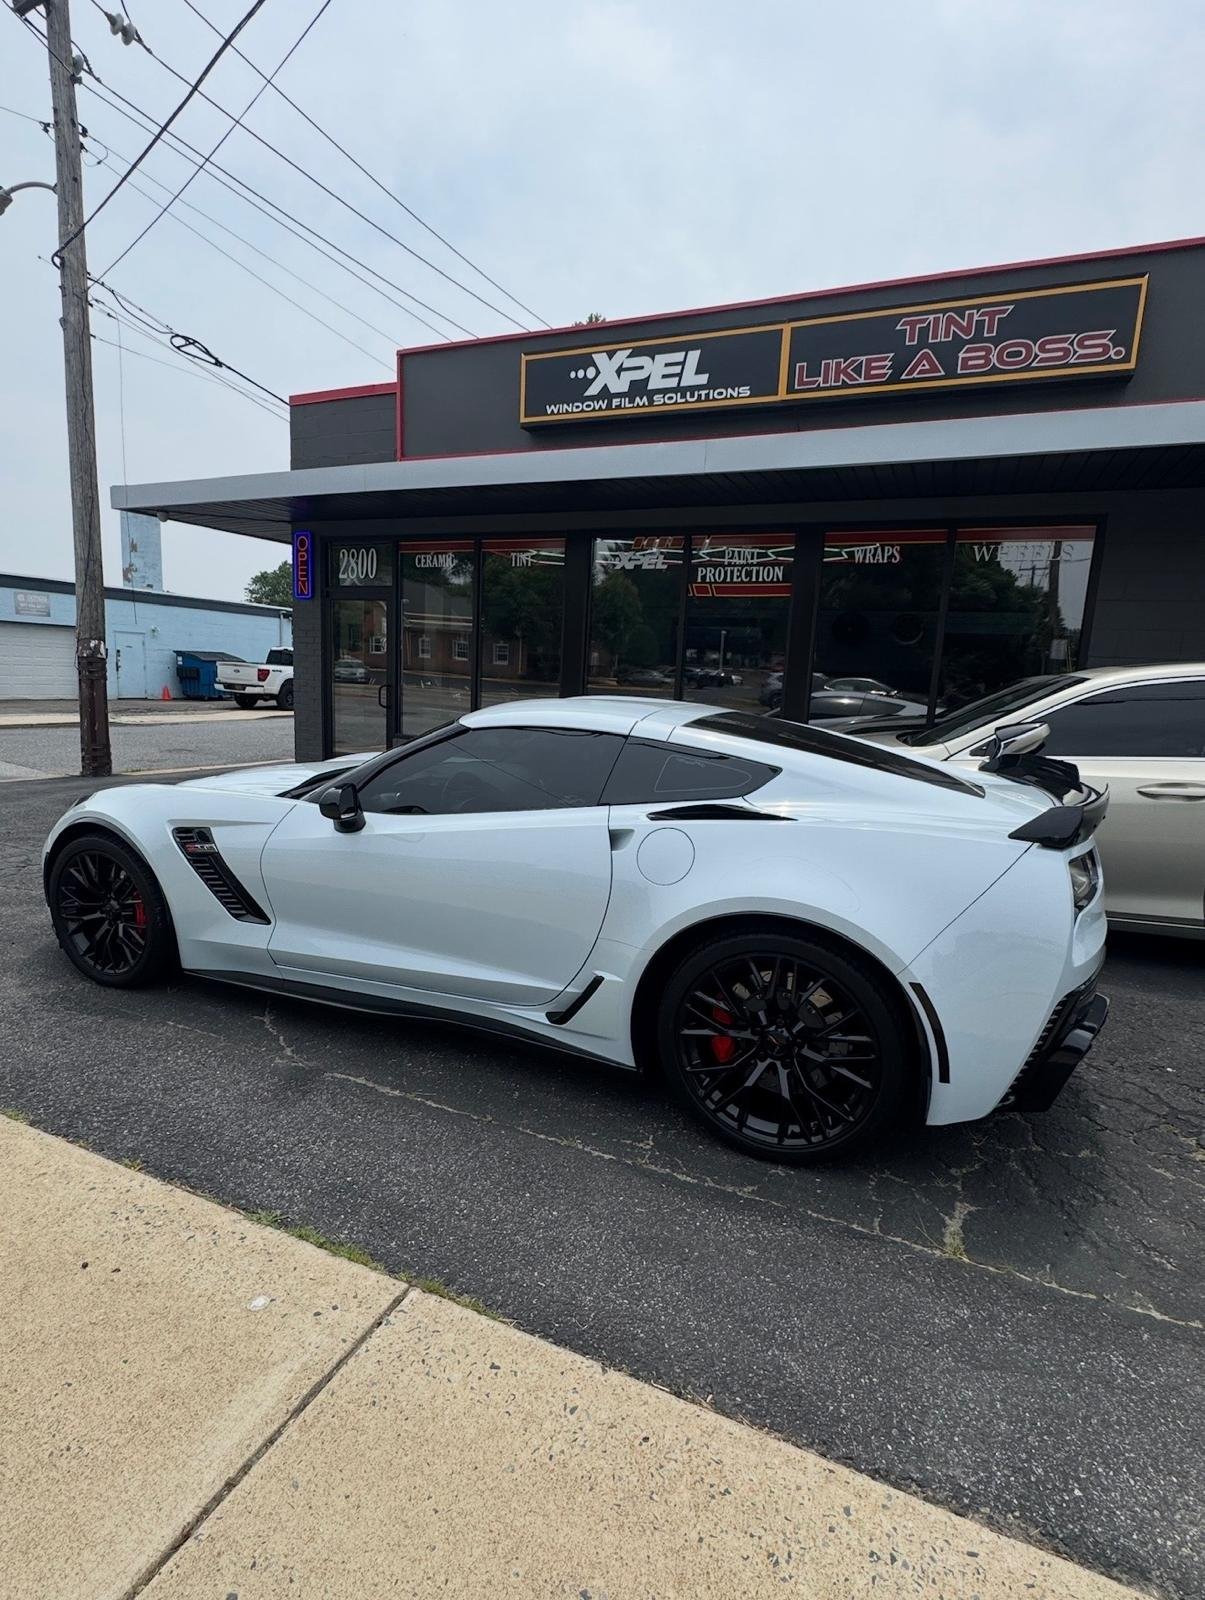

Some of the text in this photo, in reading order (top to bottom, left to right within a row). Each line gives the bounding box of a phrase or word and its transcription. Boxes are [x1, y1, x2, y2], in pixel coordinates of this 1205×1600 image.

[896, 305, 1015, 345] TINT
[795, 329, 1125, 389] LIKE A BOSS.
[583, 349, 709, 397] XPEL
[546, 386, 751, 414] WINDOW FILM SOLUTIONS
[297, 536, 308, 595] OPEN
[339, 548, 377, 579] 2800
[415, 553, 456, 568] CERAMIC
[511, 552, 532, 567] TINT
[614, 551, 668, 569] XPEL
[724, 548, 758, 565] PAINT
[854, 545, 900, 563] WRAPS
[697, 566, 784, 582] PROTECTION
